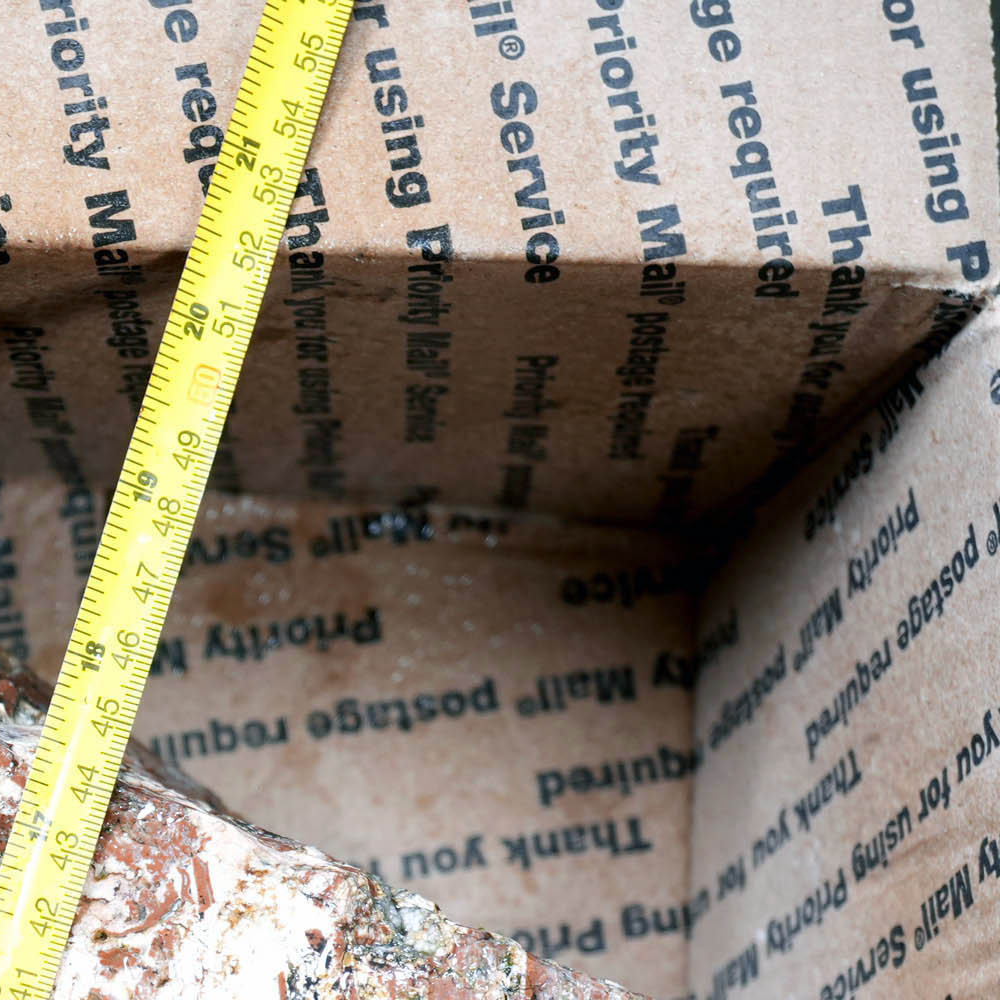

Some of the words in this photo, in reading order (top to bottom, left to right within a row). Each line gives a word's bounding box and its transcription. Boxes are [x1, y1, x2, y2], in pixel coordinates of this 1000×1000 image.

[293, 31, 324, 73] 55
[272, 98, 305, 140] 54
[365, 47, 433, 208] using
[235, 136, 261, 172] 21
[901, 67, 970, 224] using
[252, 164, 284, 206] 53
[490, 81, 566, 284] Service
[719, 79, 800, 299] required
[231, 229, 264, 273] 52
[821, 184, 873, 317] Thank
[183, 302, 210, 341] 20
[212, 299, 243, 339] 51
[172, 430, 202, 471] 49
[132, 470, 158, 503] 19
[151, 496, 182, 537] 48
[848, 486, 920, 599] Priority
[131, 560, 161, 605] 47
[896, 521, 980, 652] postage
[80, 640, 106, 673] 18
[111, 629, 141, 672] 46
[204, 606, 383, 662] Priority
[307, 677, 500, 740] postage
[516, 664, 639, 719] Mail®
[804, 638, 893, 763] required
[90, 696, 121, 738] 45
[70, 764, 100, 804] 44
[790, 747, 864, 834] Thank
[918, 765, 953, 824] for
[50, 829, 80, 872] 43
[402, 832, 488, 882] you
[503, 813, 652, 857] Thank
[851, 805, 914, 884] using
[29, 896, 59, 938] 42
[765, 867, 850, 960] Priority
[914, 862, 975, 953] Mail®
